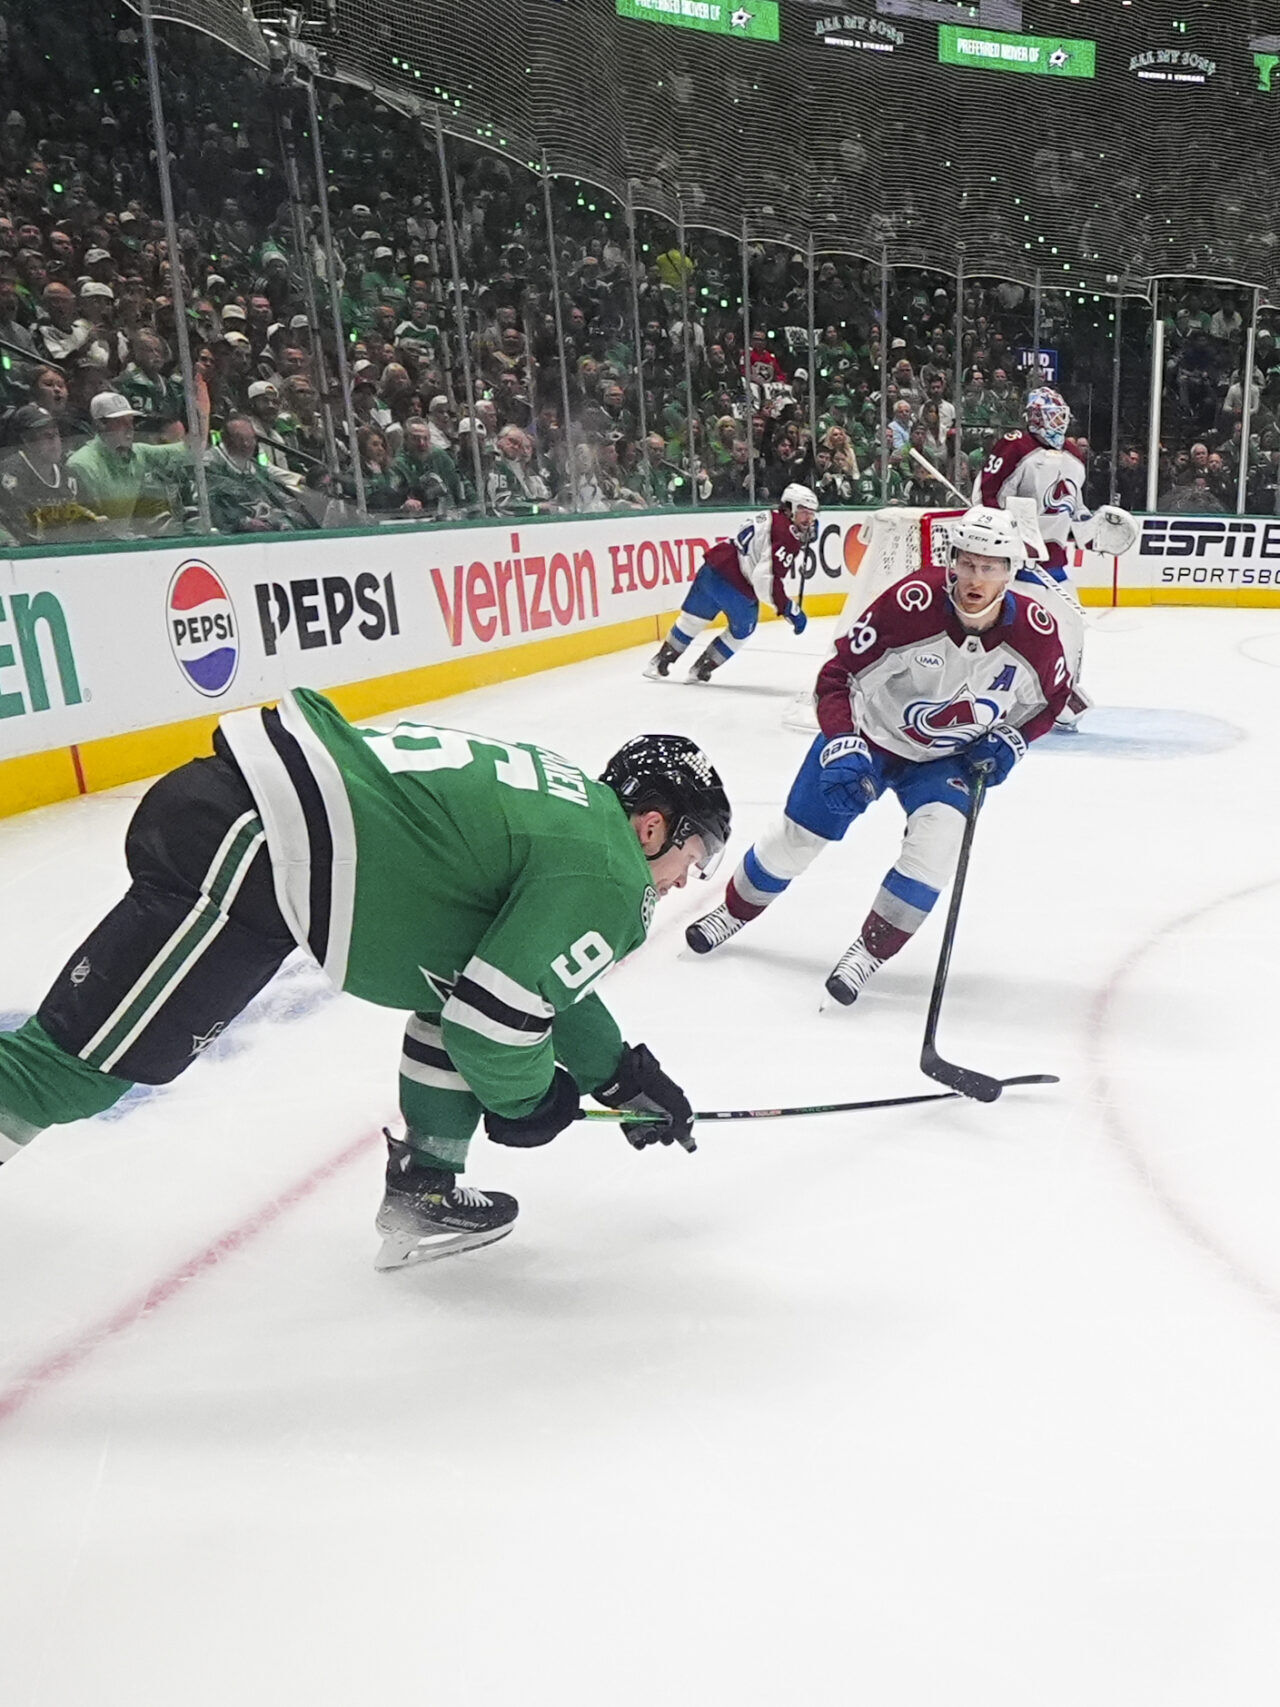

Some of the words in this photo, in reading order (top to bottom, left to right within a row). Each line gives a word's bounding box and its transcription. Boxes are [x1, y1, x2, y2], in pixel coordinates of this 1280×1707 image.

[984, 454, 1004, 474] 39
[608, 536, 730, 595] HOND
[774, 546, 794, 568] 49
[429, 531, 601, 647] verizon
[172, 615, 233, 646] PEPSI
[254, 571, 401, 657] PEPSI
[847, 611, 877, 655] 29
[919, 656, 941, 667] IMA
[1053, 656, 1073, 687] 2
[550, 930, 616, 1004] 9
